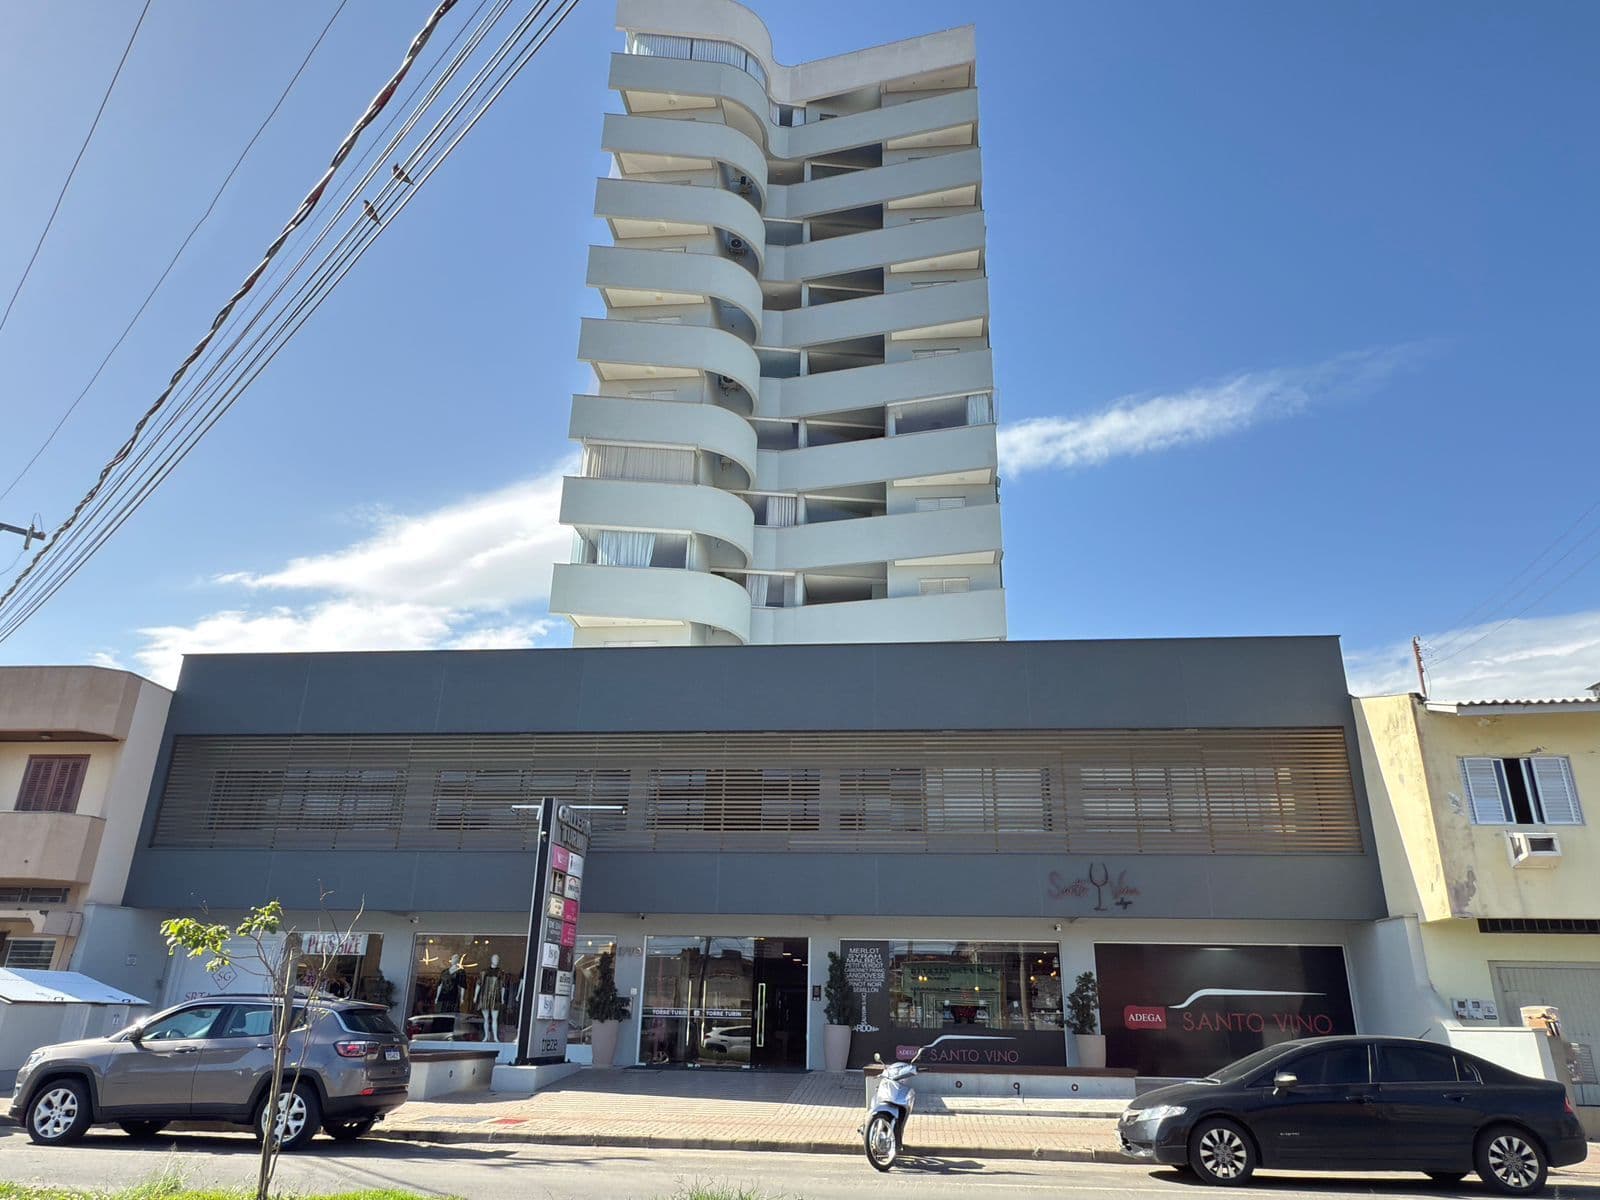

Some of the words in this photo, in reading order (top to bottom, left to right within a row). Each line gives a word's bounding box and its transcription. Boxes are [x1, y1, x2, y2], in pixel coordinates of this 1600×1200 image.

[307, 934, 336, 954] PLUS
[217, 971, 232, 982] SG
[1128, 1013, 1162, 1022] ADEGA
[1183, 1011, 1265, 1033] SANTO
[1272, 1013, 1334, 1035] VINO
[930, 1049, 980, 1062] SANTO
[984, 1050, 1020, 1063] VINO
